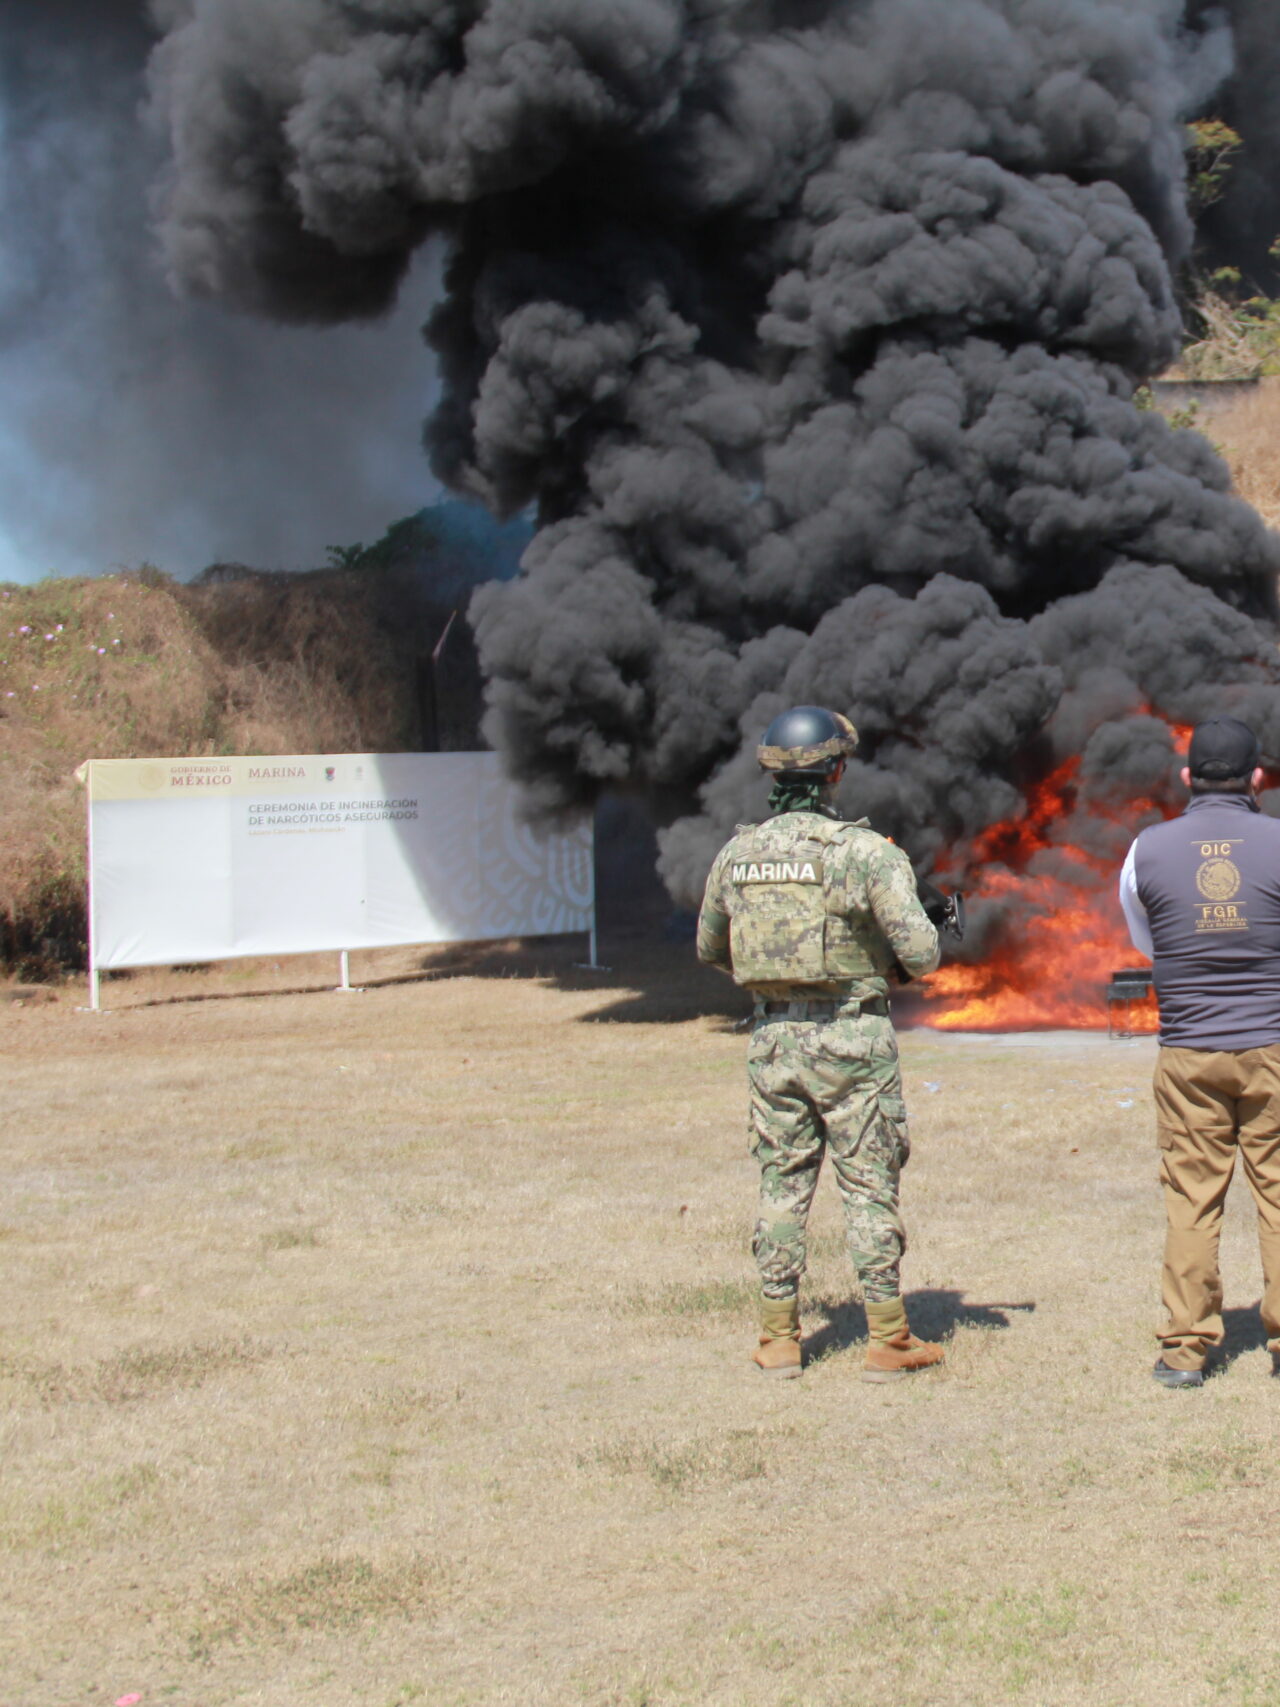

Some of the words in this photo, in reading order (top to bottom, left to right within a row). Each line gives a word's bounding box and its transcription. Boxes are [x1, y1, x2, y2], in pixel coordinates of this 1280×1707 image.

[249, 767, 306, 778] MARINA
[170, 773, 232, 786] MÉXICO
[249, 804, 317, 813] CEREMONIA
[321, 802, 336, 811] DE
[339, 799, 418, 810] INCINERACIÓN
[249, 816, 264, 825] DE
[267, 813, 341, 824] NARCÓTICOS
[345, 810, 418, 821] ASEGURADOS
[1201, 843, 1231, 856] OIC
[733, 862, 816, 882] MARINA
[1203, 906, 1237, 918] FGR
